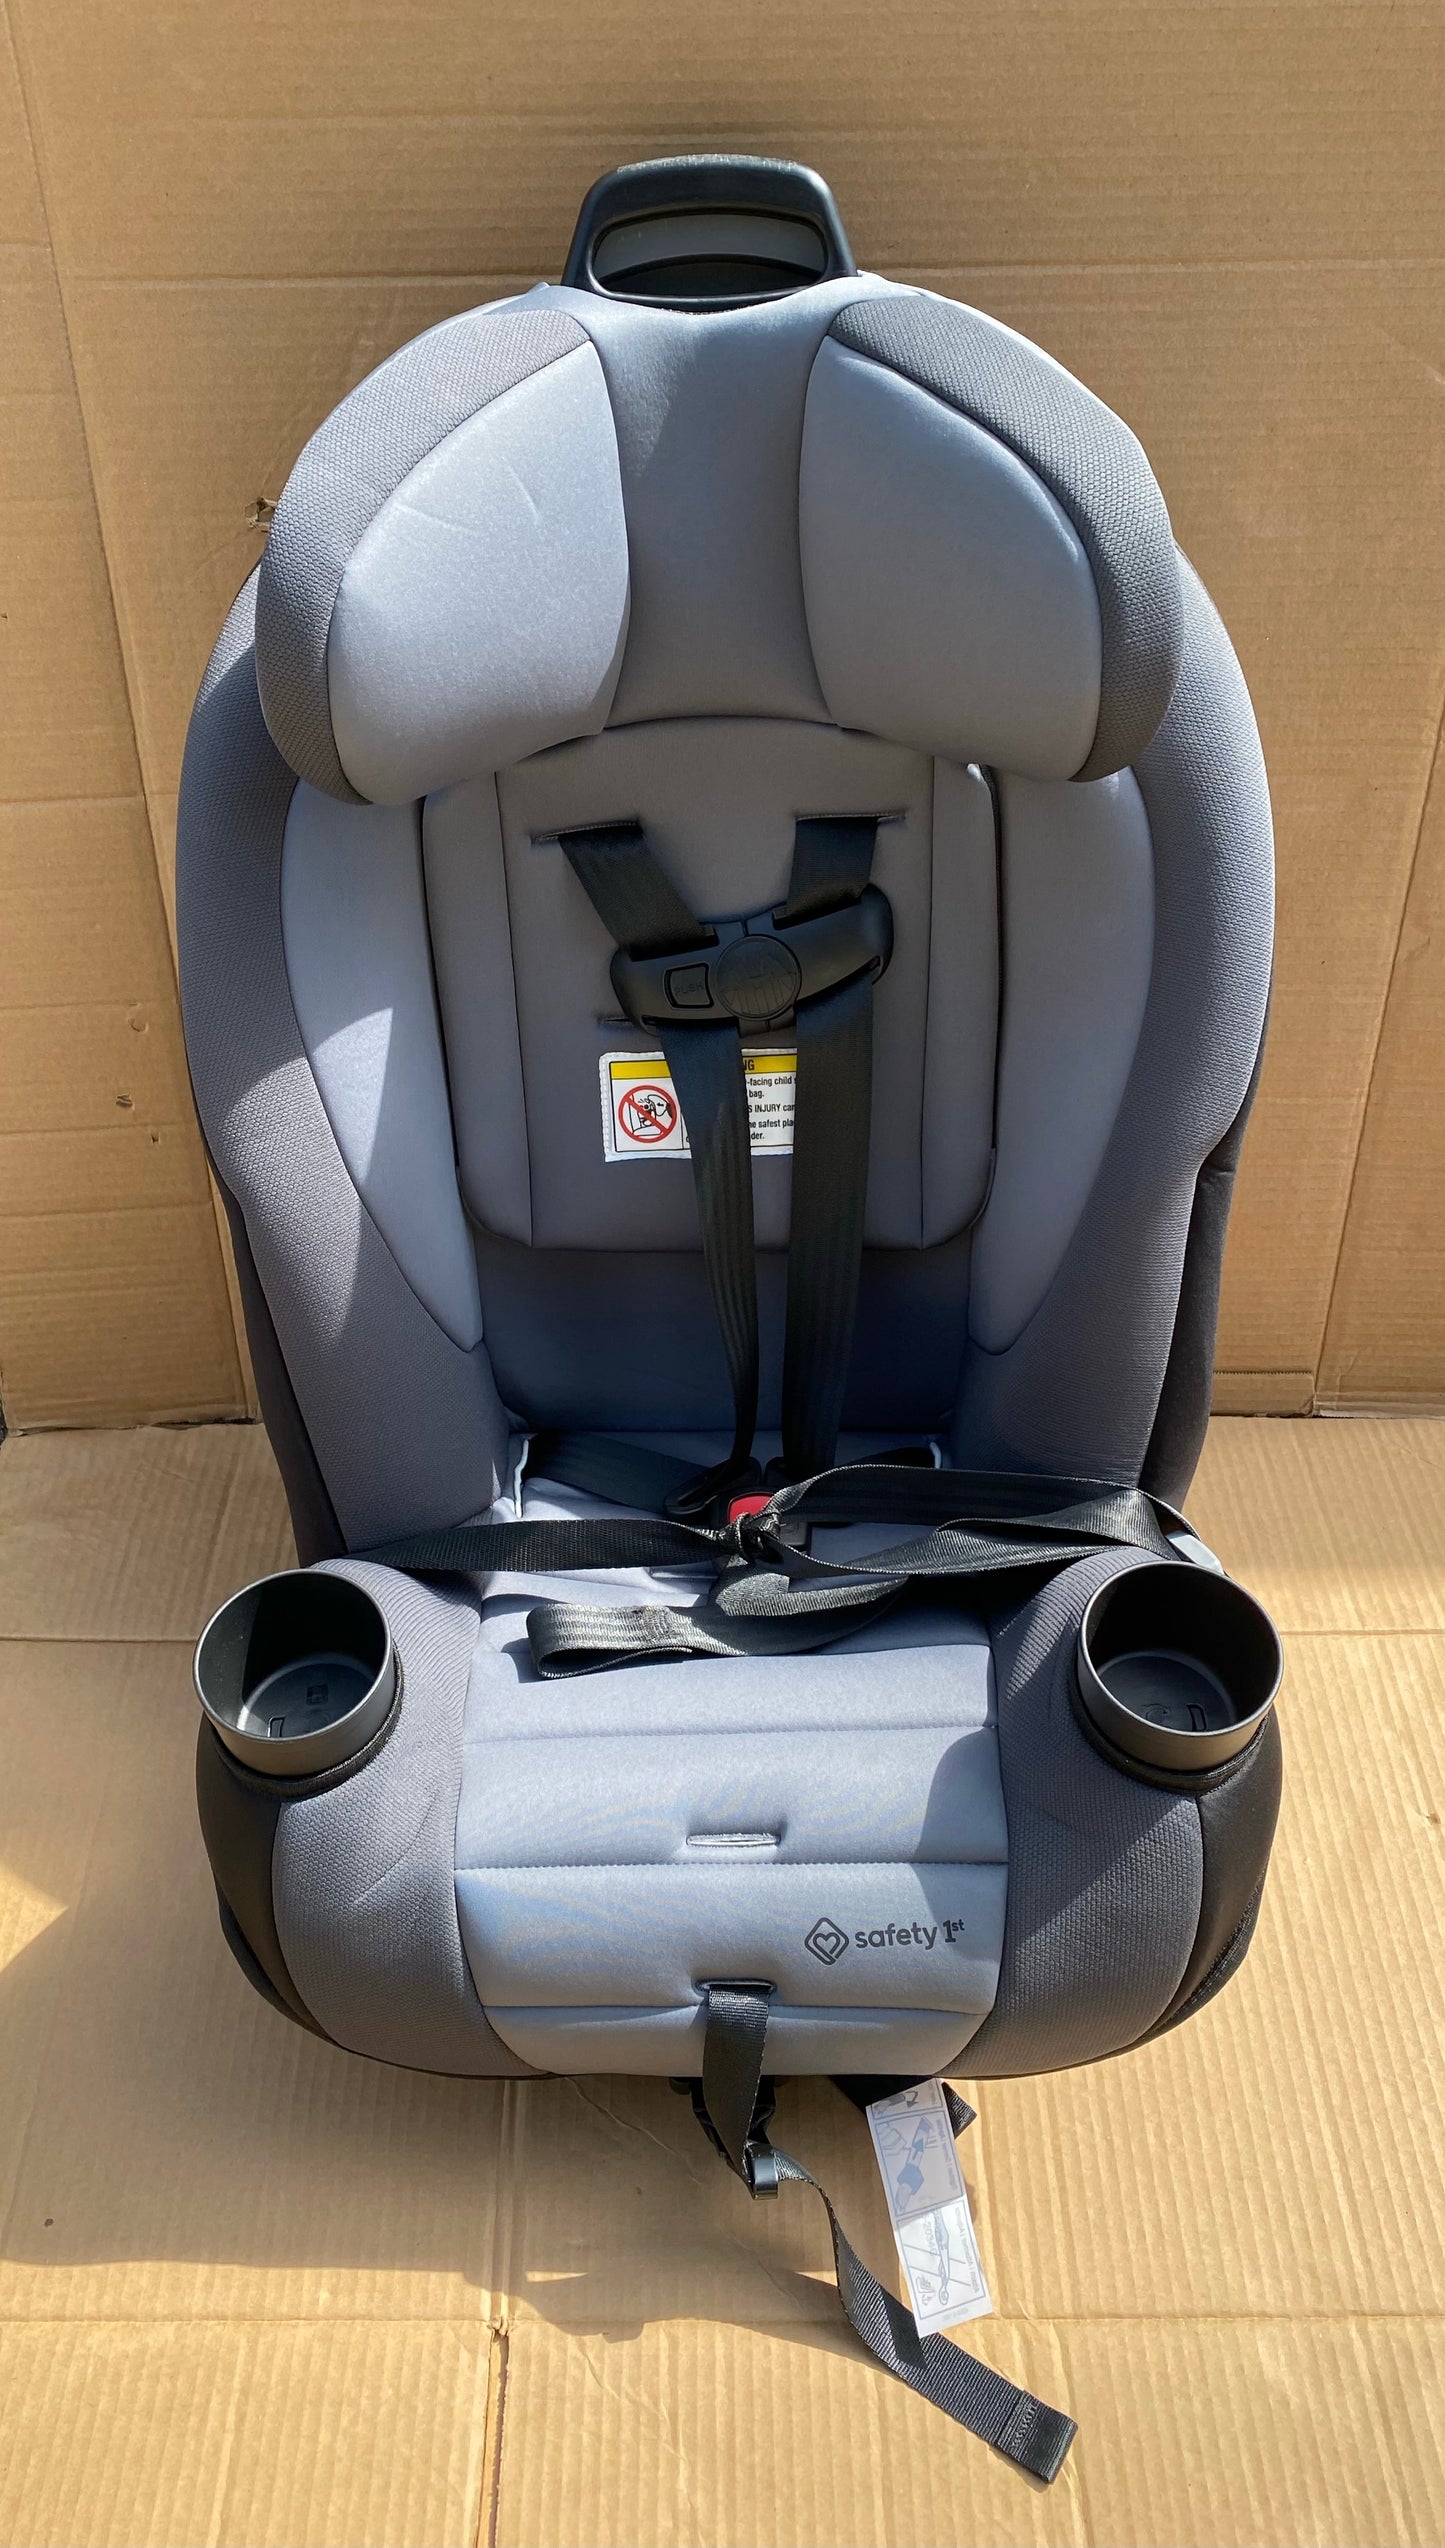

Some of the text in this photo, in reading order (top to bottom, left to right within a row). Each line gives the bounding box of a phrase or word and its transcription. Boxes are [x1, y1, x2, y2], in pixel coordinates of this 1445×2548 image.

[774, 1075, 792, 1085] child
[749, 1090, 765, 1099] bag.
[754, 1104, 781, 1112] INJURY
[758, 1119, 781, 1128] safest
[854, 1918, 965, 1951] safety 1st
